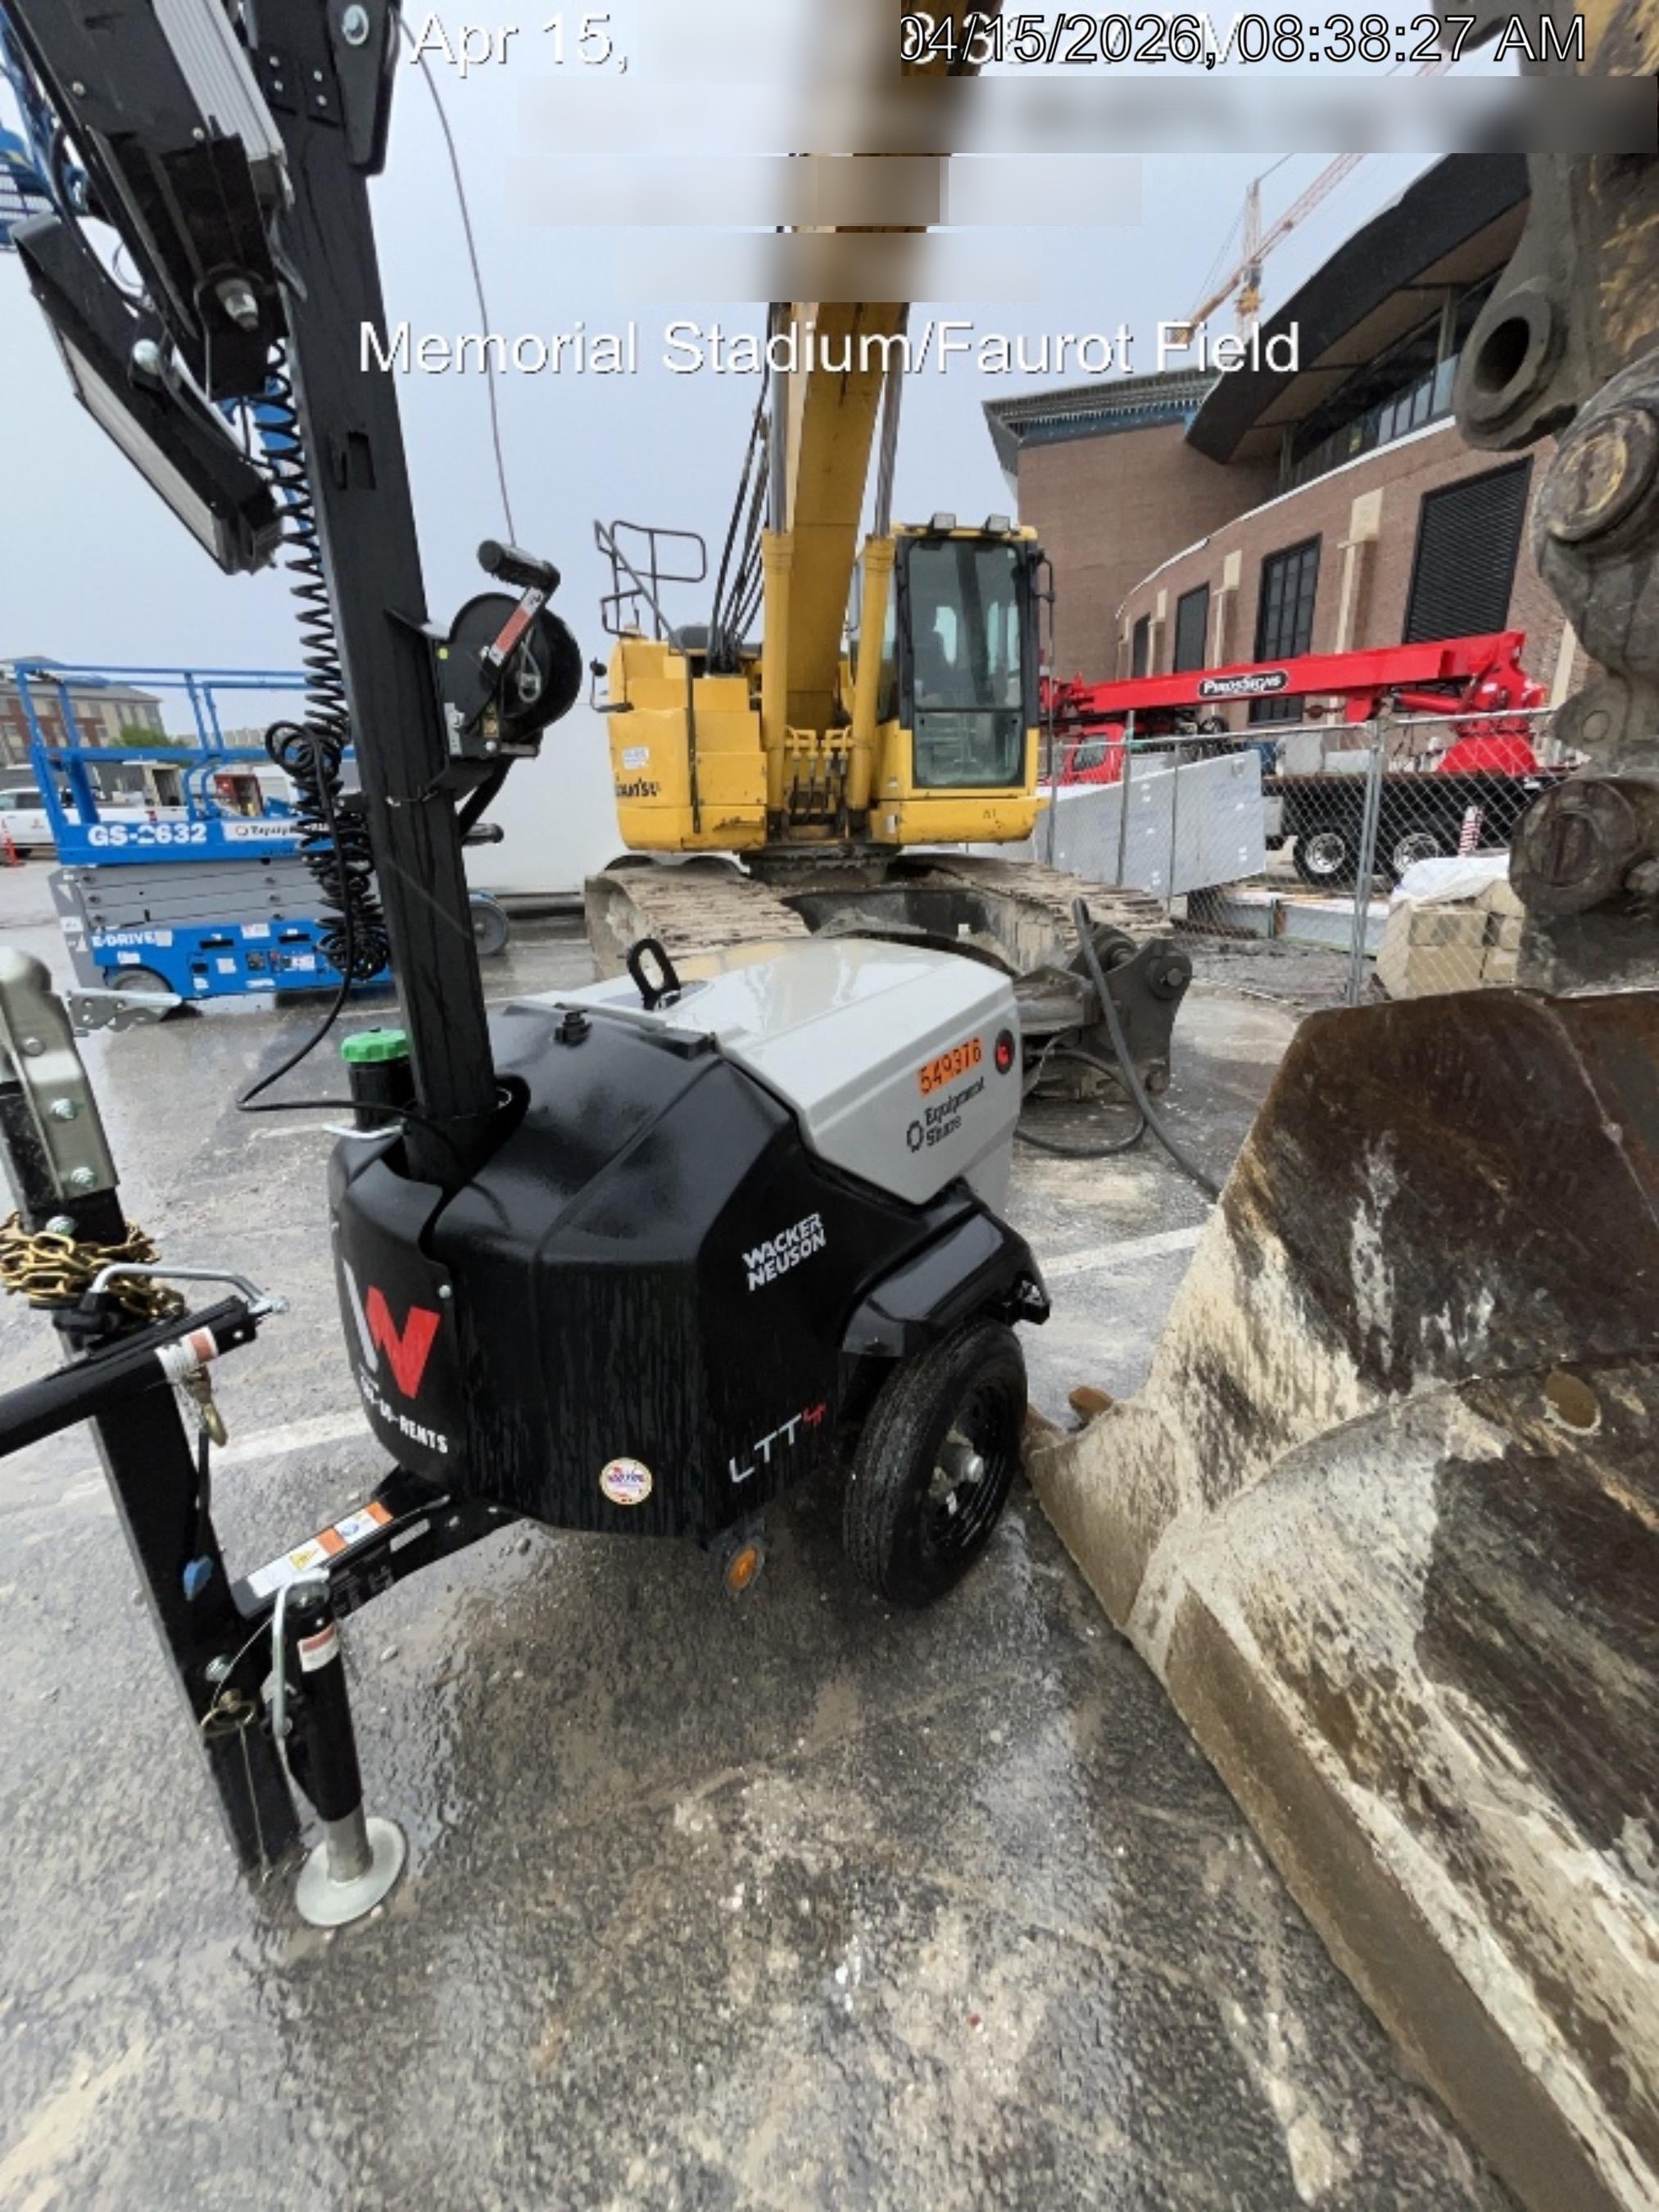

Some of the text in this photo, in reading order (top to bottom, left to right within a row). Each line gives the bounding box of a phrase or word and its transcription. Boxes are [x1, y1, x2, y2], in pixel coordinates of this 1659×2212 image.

[87, 821, 207, 846] GS-2632
[920, 1037, 981, 1095] 549376
[924, 1075, 986, 1127] Equipment
[926, 1115, 962, 1147] Share
[741, 1212, 824, 1270] WACKER
[747, 1228, 827, 1292] NEUSON
